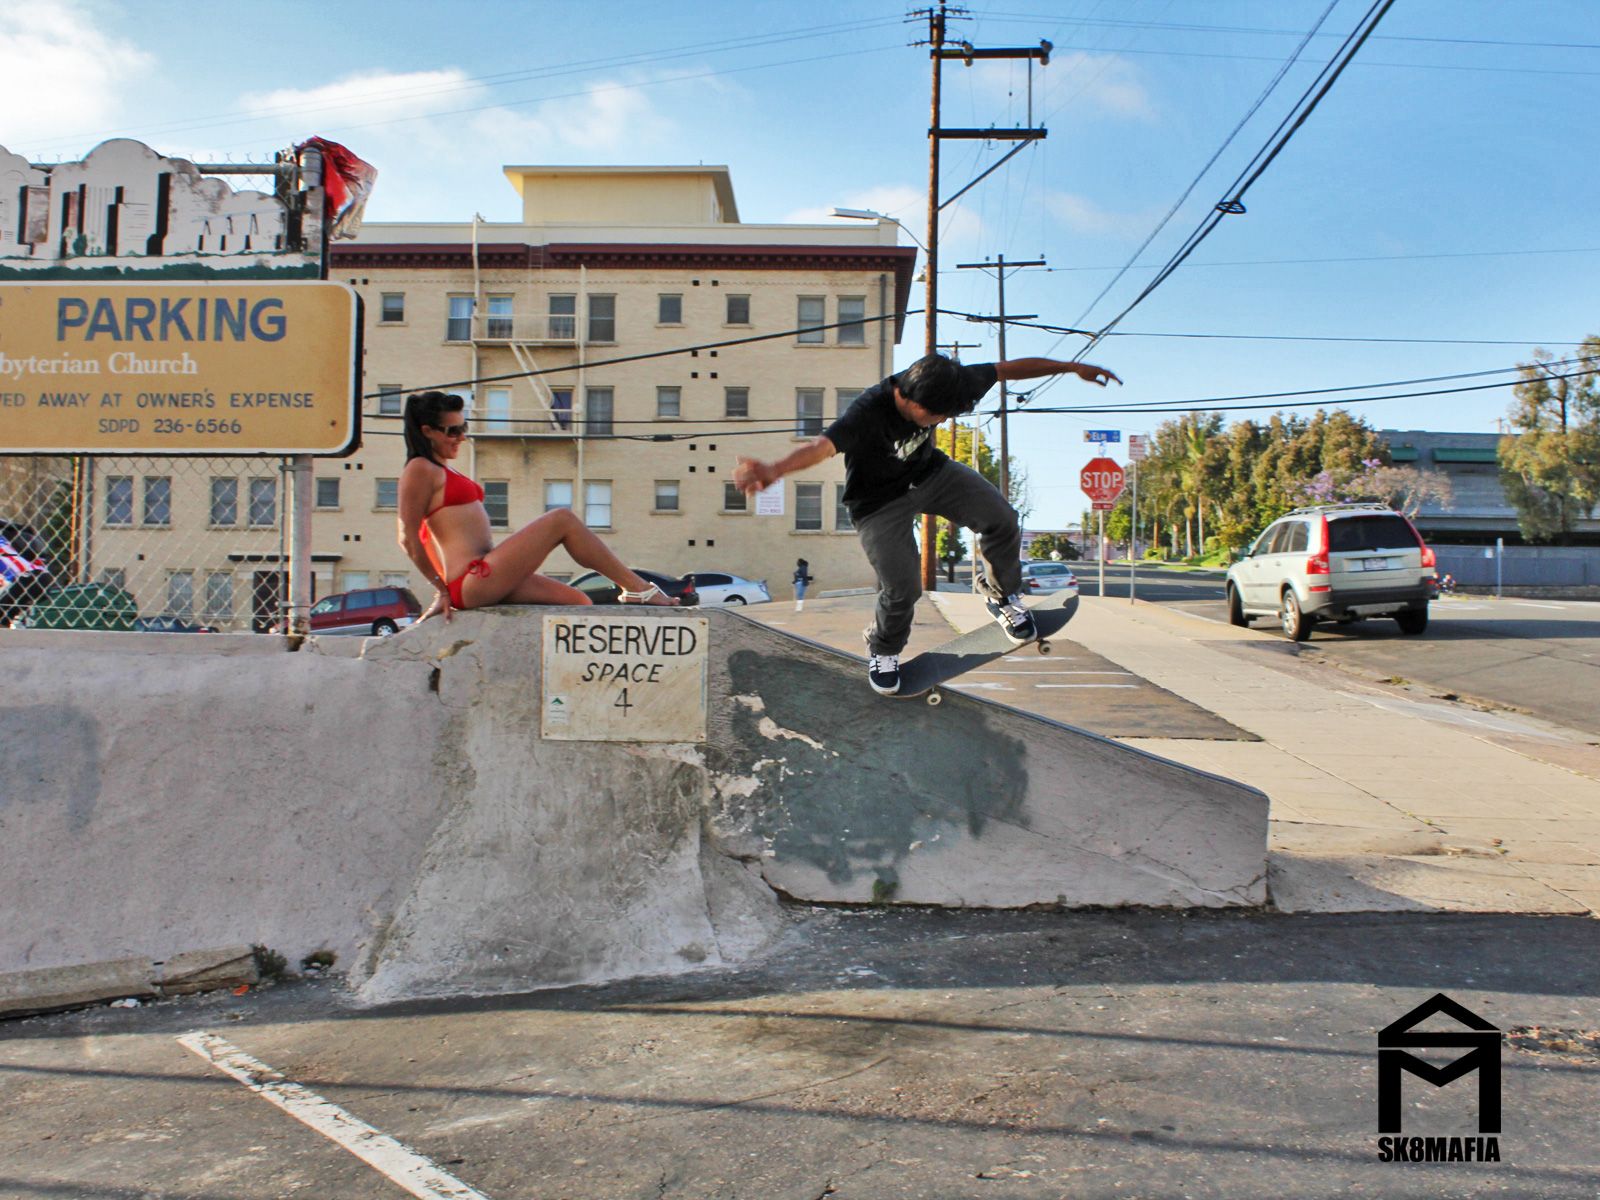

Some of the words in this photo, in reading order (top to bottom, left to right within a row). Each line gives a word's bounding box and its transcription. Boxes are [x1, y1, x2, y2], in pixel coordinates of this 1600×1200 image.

[57, 297, 288, 342] PARKING
[108, 352, 198, 375] Church
[0, 393, 25, 408] ED
[38, 392, 91, 408] AWAY
[100, 392, 122, 408] AT
[136, 388, 216, 409] OWNER'S
[230, 392, 314, 408] EXPENSE
[98, 418, 140, 434] SDPD
[153, 418, 242, 434] 236-6566
[1082, 471, 1122, 489] STOP
[555, 624, 697, 656] RESERVED
[581, 662, 664, 684] SPACE
[613, 687, 634, 718] 4
